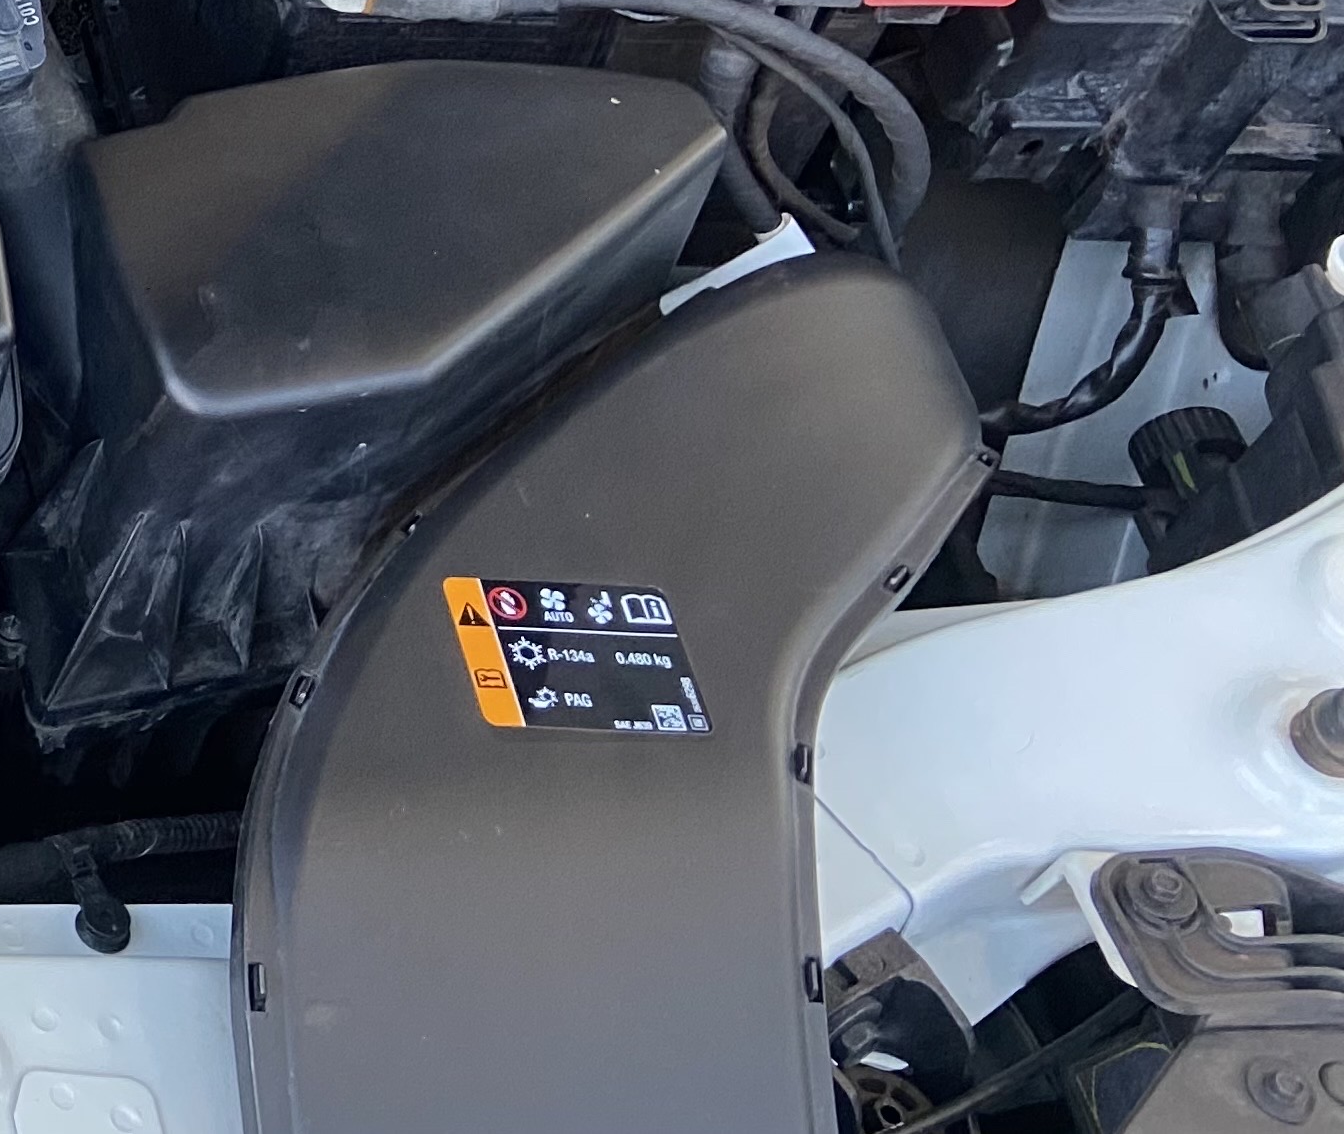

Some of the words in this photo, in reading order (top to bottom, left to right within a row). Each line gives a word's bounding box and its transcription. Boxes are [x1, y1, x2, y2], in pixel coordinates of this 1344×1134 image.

[543, 610, 575, 624] AUTO
[546, 647, 596, 664] R-134a
[615, 651, 652, 666] 0.480
[653, 653, 672, 669] kg
[563, 692, 594, 708] PAG
